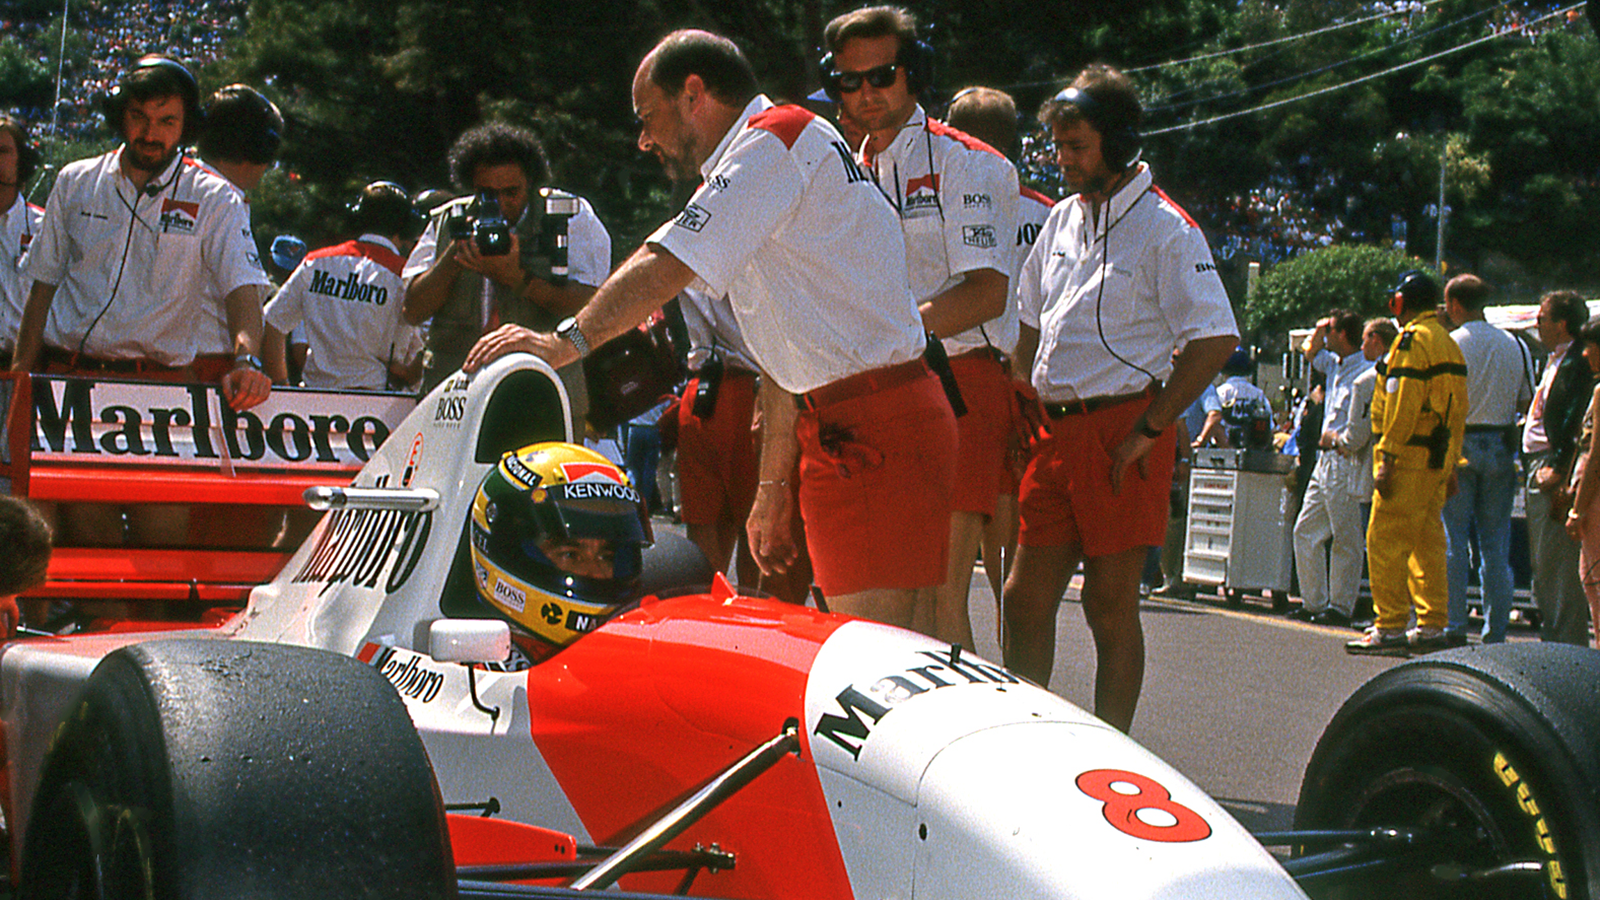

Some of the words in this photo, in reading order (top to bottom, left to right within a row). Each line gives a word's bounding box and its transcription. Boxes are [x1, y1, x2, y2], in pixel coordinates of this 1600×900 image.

[309, 269, 388, 306] Marlboro
[31, 379, 392, 463] Marlboro
[436, 396, 466, 421] BOSS
[564, 483, 640, 503] KENWOOD
[496, 581, 525, 604] BOSS
[376, 647, 444, 703] Marlboro
[1075, 768, 1212, 843] 8
